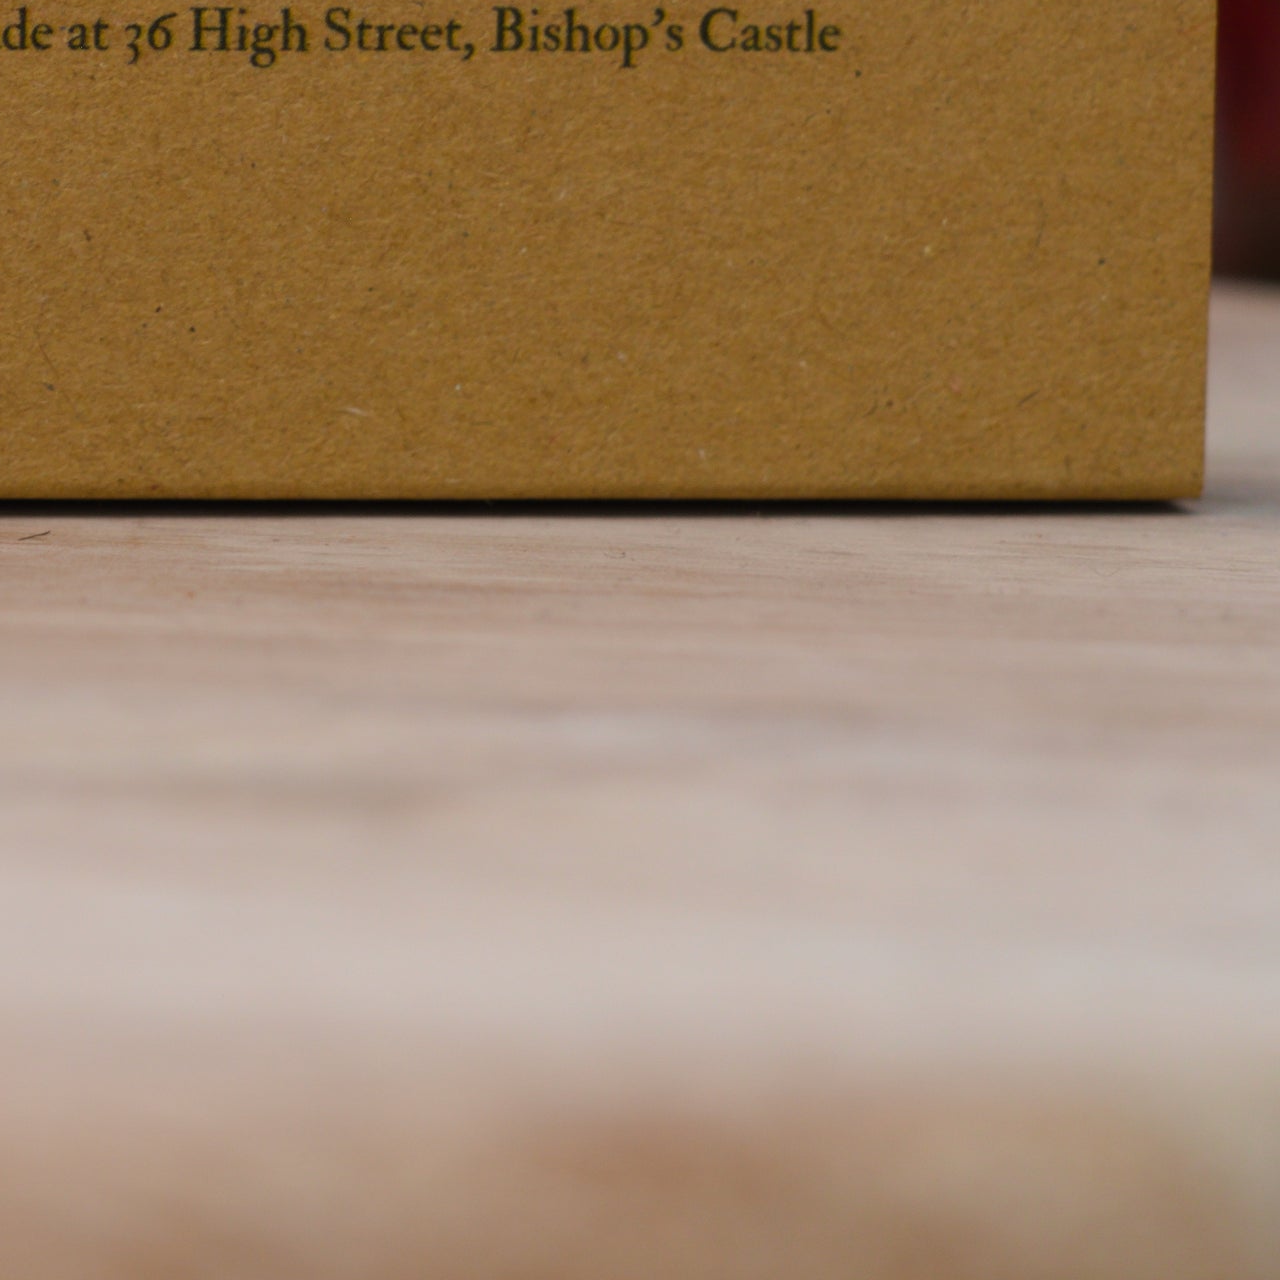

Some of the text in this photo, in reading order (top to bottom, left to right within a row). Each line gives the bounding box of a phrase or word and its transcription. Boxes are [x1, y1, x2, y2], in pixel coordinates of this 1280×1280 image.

[67, 17, 110, 52] at
[124, 11, 178, 65] 36
[188, 6, 311, 69] High
[323, 6, 476, 62] Street,
[489, 5, 684, 70] Bishop's
[698, 6, 842, 53] Castle
